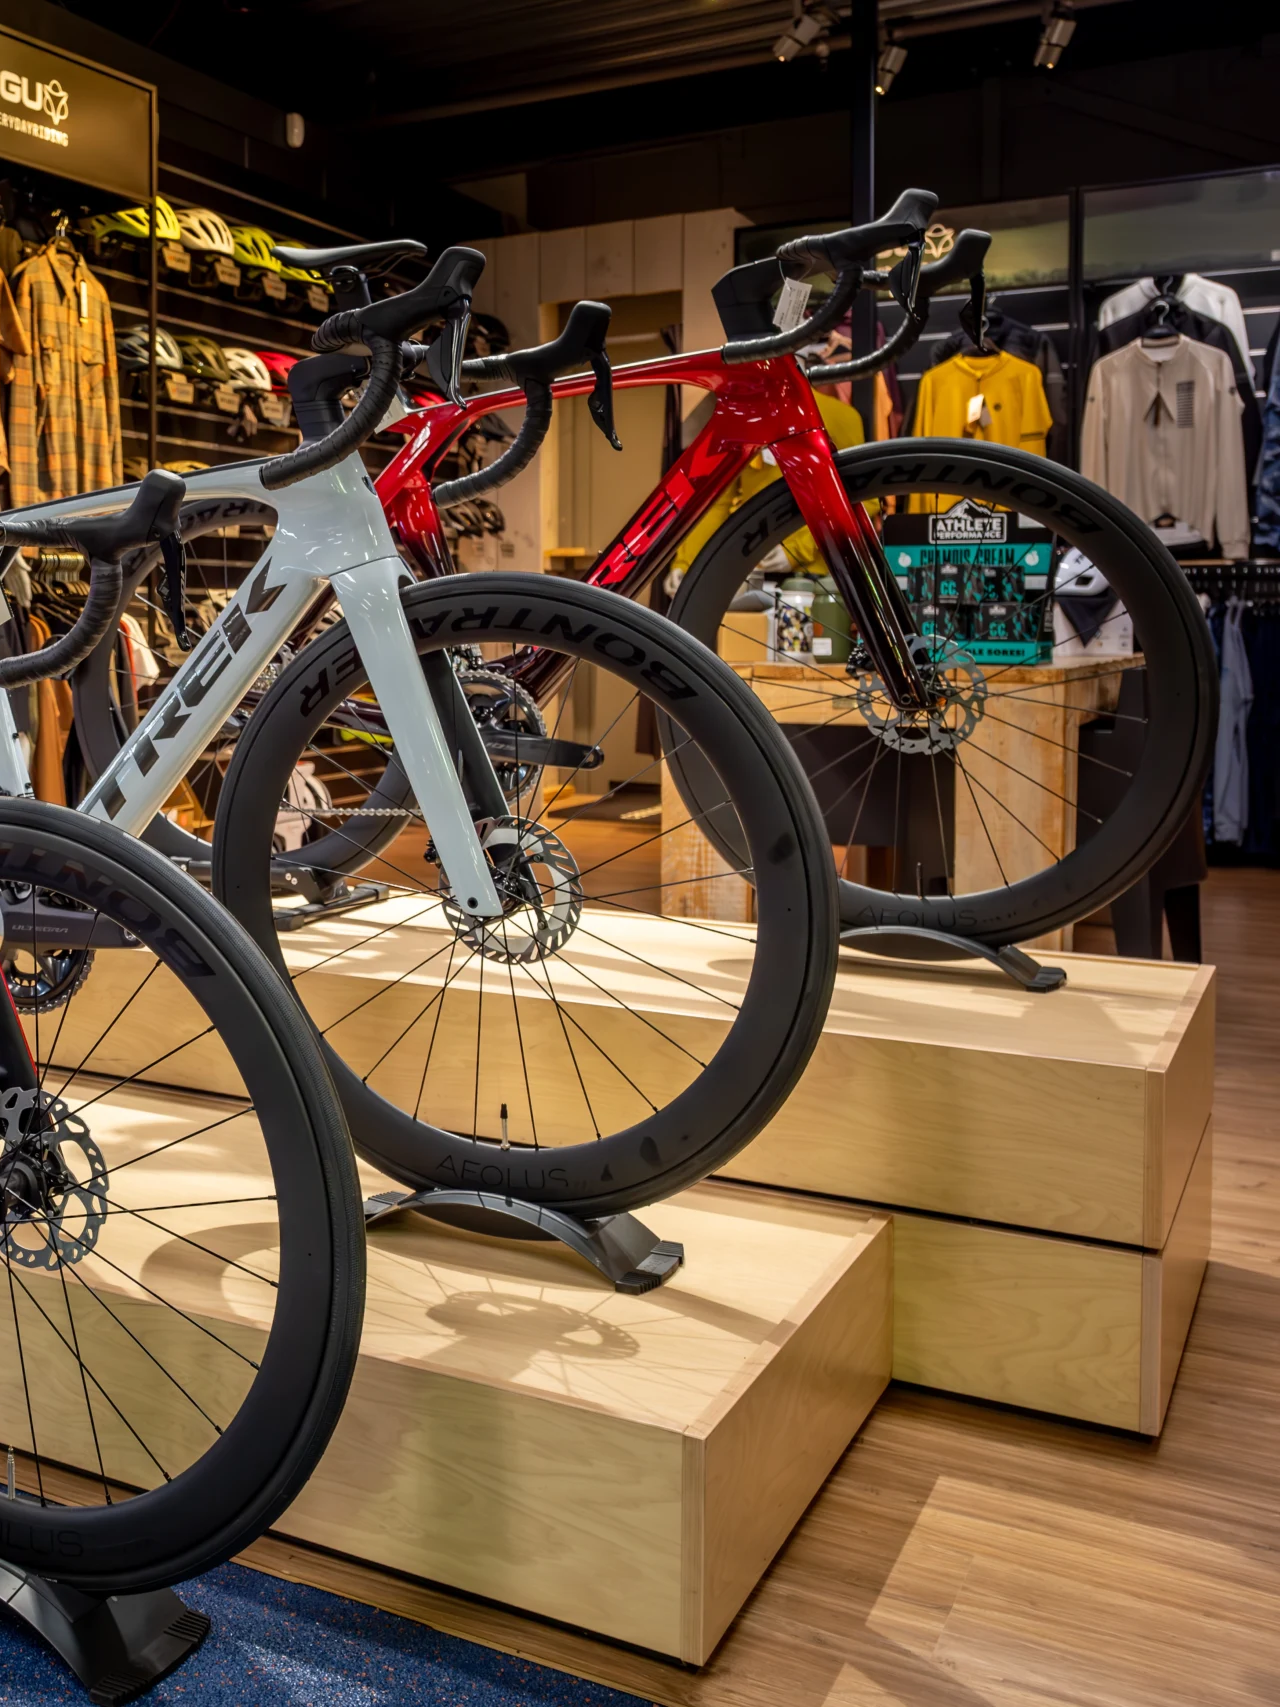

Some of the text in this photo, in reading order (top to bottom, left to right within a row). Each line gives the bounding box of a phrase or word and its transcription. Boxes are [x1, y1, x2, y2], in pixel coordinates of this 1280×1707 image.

[587, 430, 728, 587] REK
[741, 462, 1104, 557] BONTRAER
[936, 518, 1002, 532] ATHLETE
[974, 548, 1015, 565] CREAM
[300, 605, 699, 718] BONTRAER
[987, 648, 1025, 657] SORES!
[80, 556, 288, 822] TREK
[12, 924, 69, 934] ULTEGRA
[435, 1153, 569, 1189] AEOLUS
